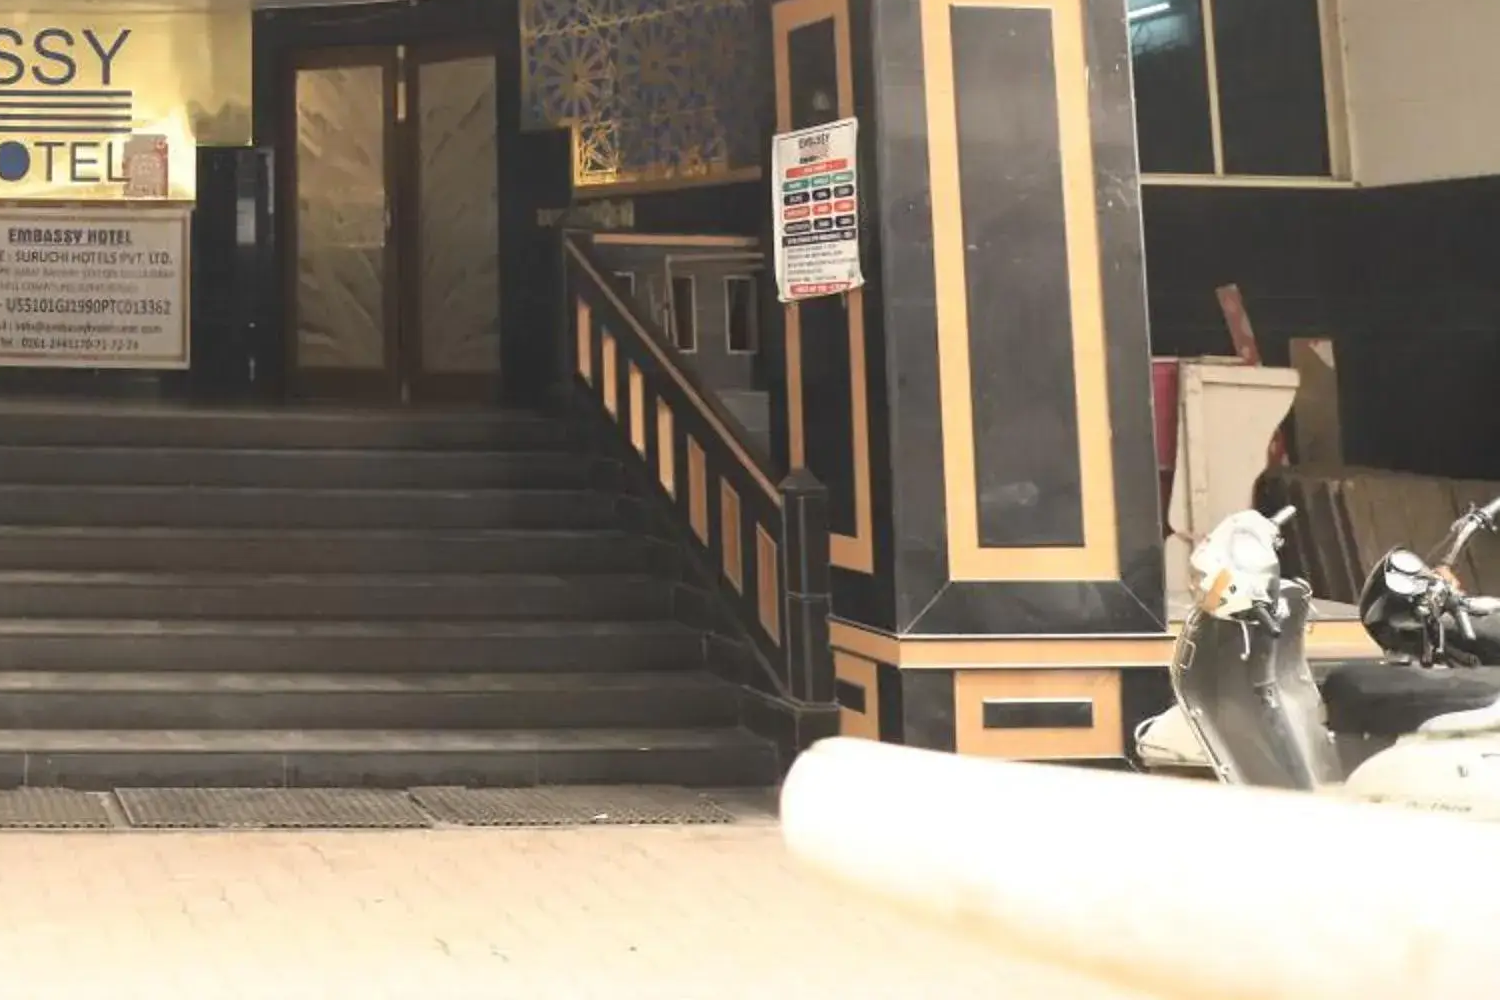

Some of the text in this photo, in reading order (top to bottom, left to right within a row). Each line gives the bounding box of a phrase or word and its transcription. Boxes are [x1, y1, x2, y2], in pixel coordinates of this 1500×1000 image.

[8, 228, 133, 245] EMBASSY HOTEL
[71, 250, 117, 264] HOTELS
